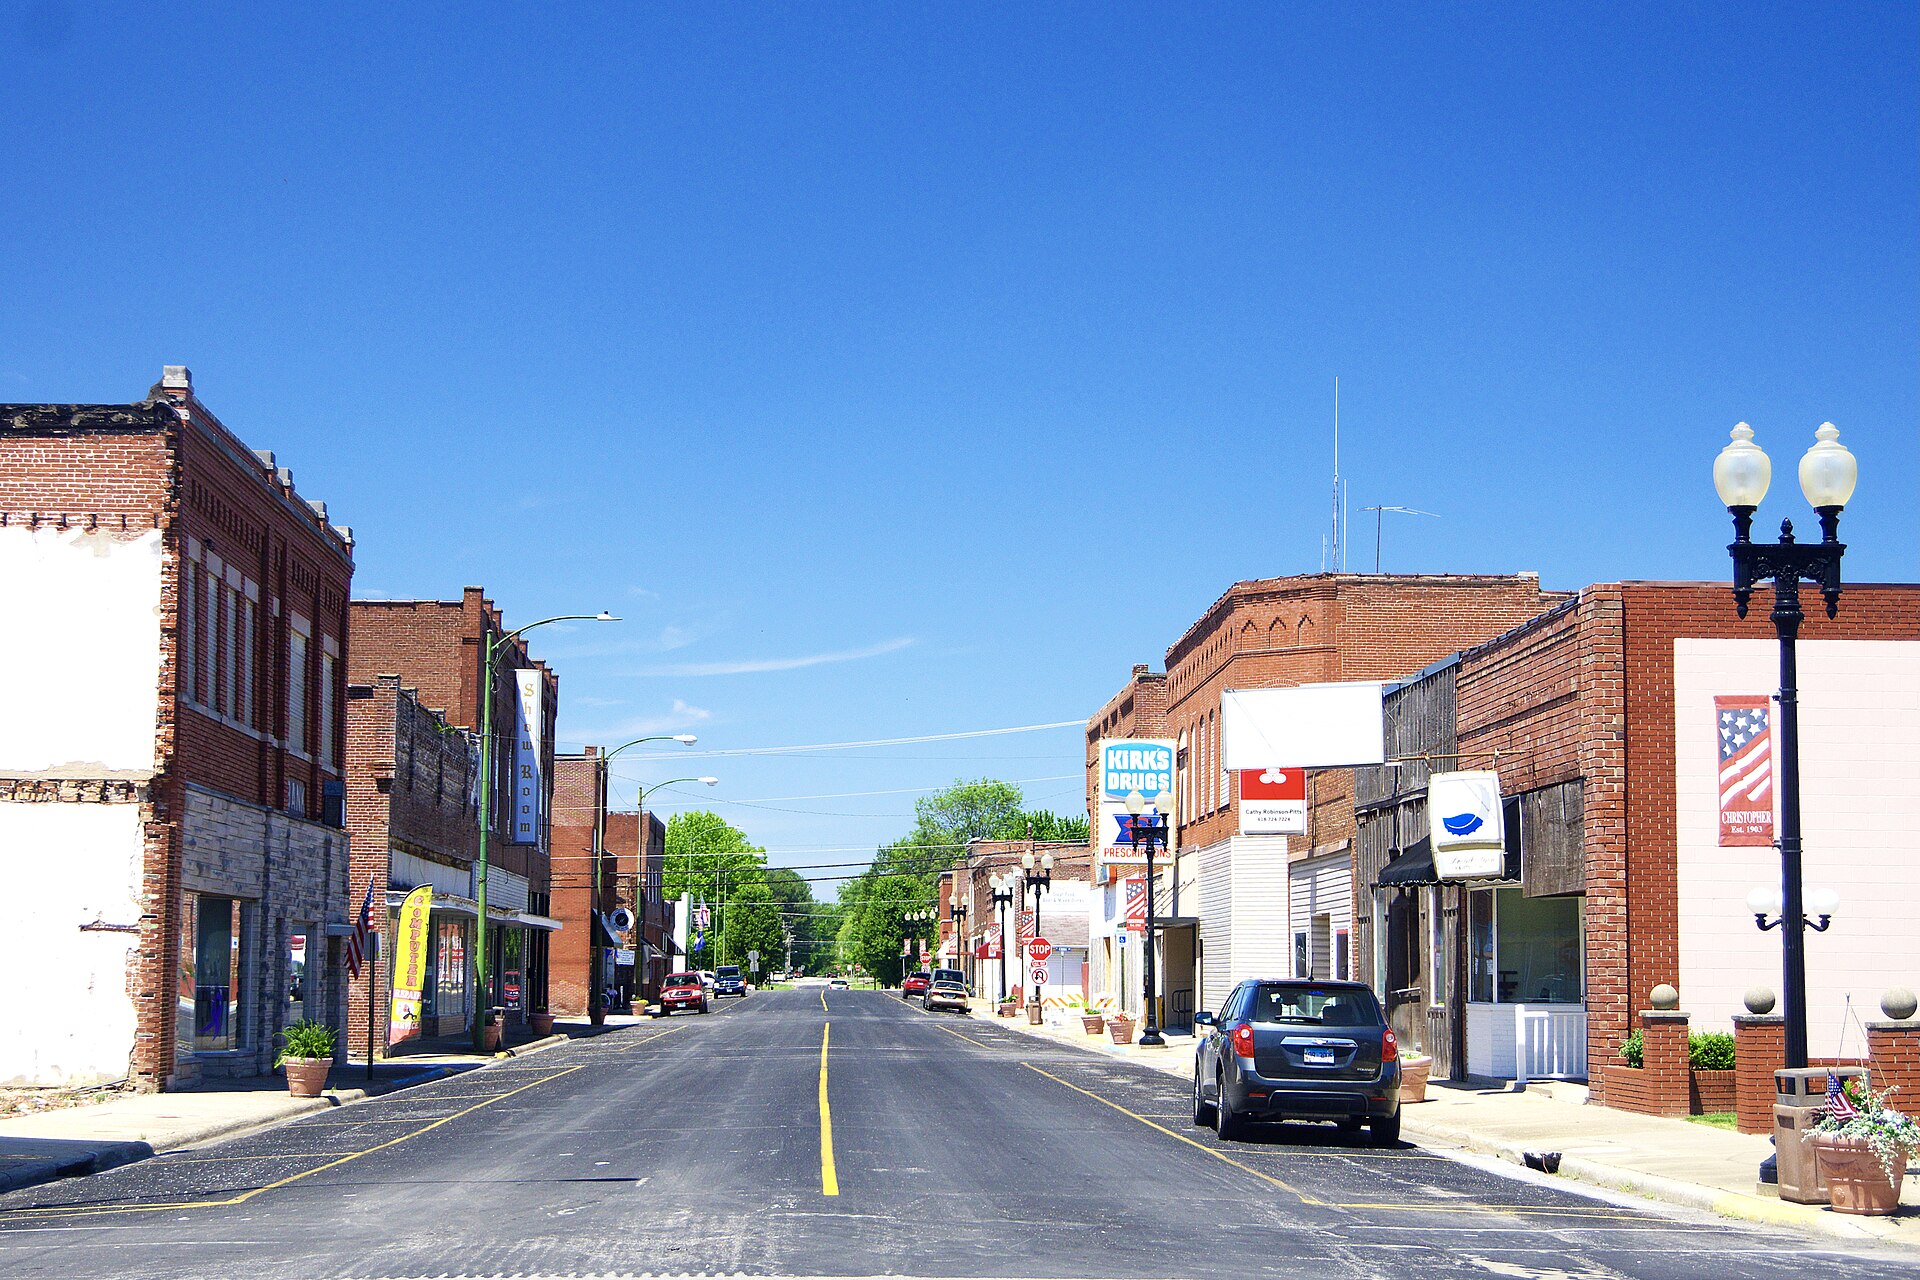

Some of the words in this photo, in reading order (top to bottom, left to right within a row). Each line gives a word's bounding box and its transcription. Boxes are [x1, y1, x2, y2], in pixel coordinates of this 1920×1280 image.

[522, 683, 534, 750] Show
[1107, 748, 1170, 770] KIRK'S
[1107, 772, 1170, 791] DRUGS
[519, 765, 533, 832] Room
[1721, 811, 1772, 824] CHRISTOPHER
[1104, 847, 1172, 859] PRESCRIPONS
[405, 895, 424, 987] COMPUTER
[1029, 945, 1050, 954] STOP
[393, 989, 422, 1001] REPAIR
